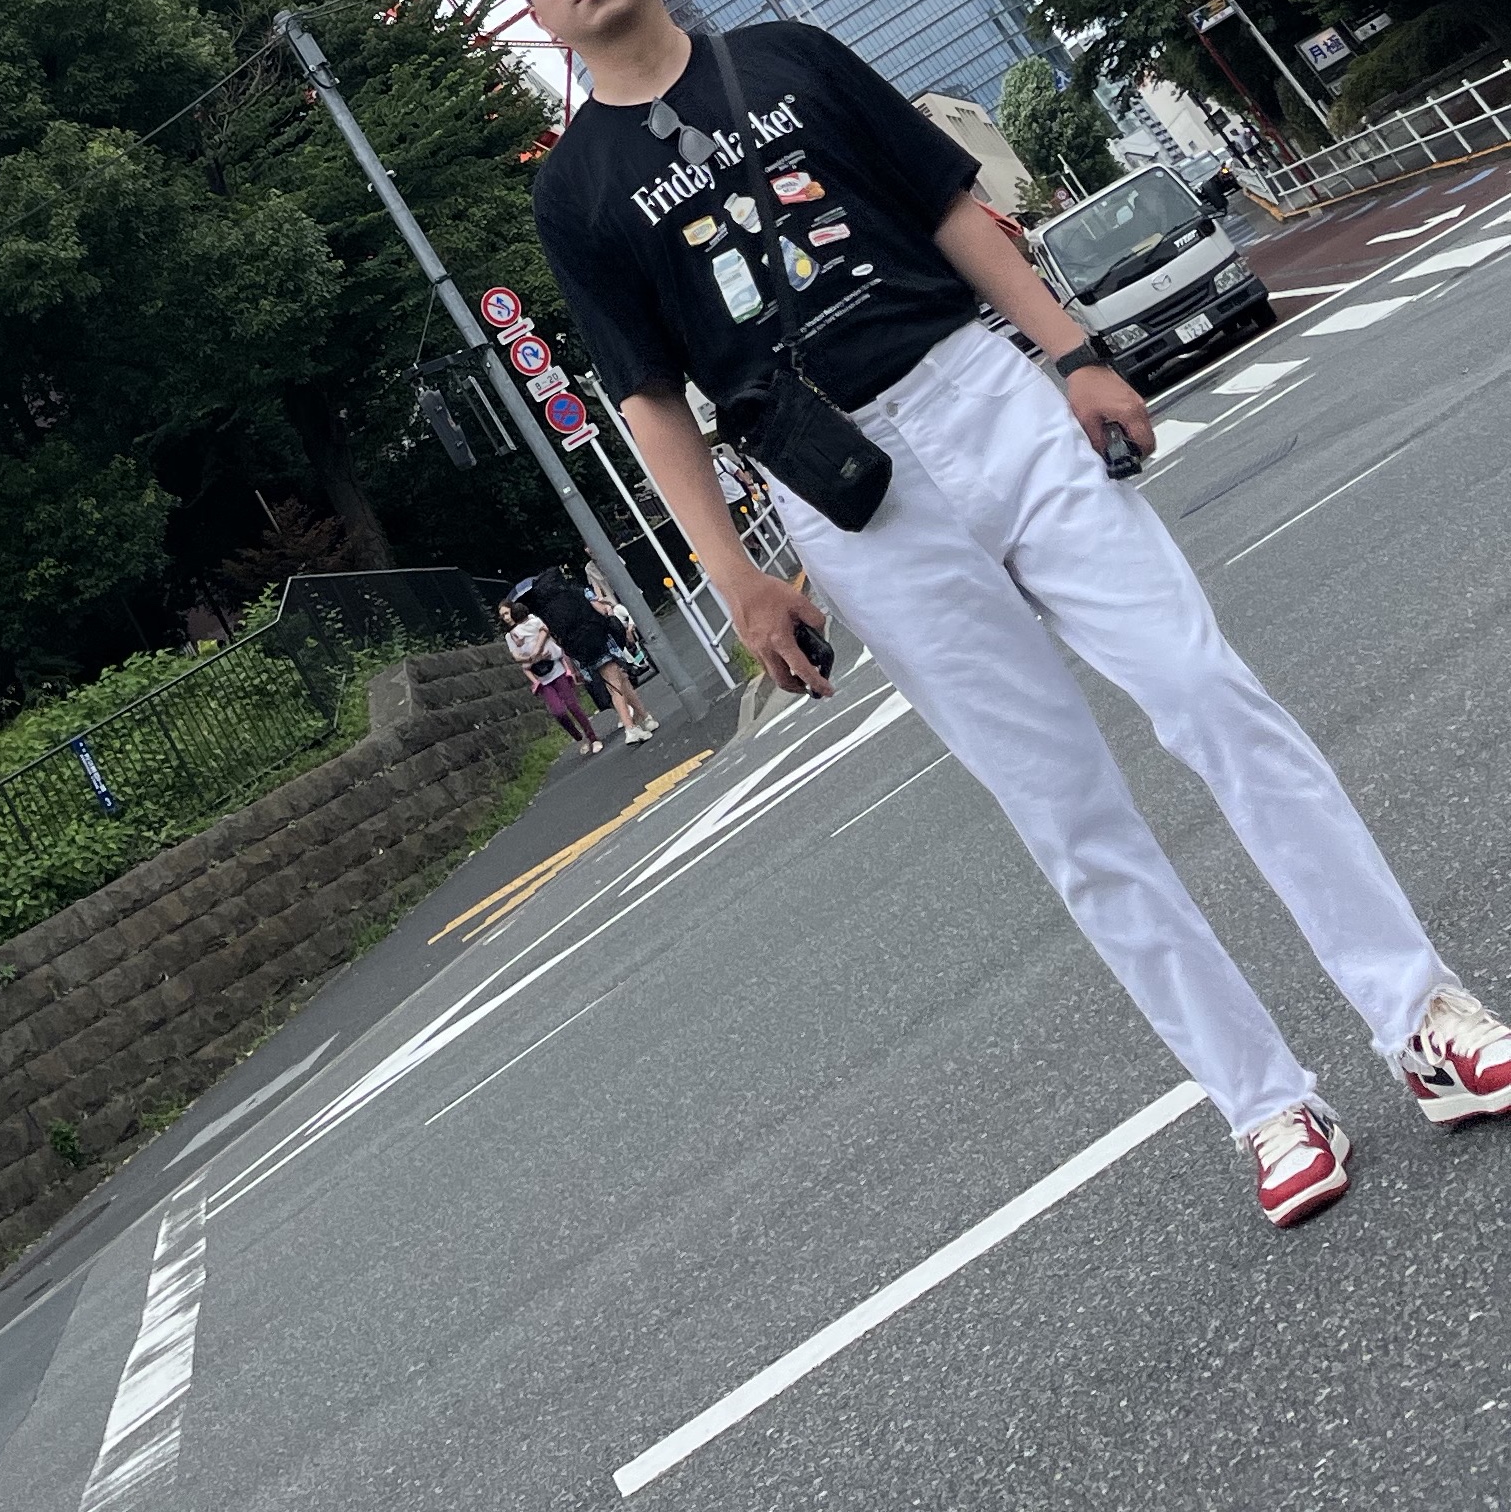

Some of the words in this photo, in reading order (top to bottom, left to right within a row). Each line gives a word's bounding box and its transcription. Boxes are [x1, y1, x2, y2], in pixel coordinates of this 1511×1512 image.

[1309, 34, 1345, 64] 月極
[630, 162, 716, 226] Friday
[712, 102, 804, 170] Maket
